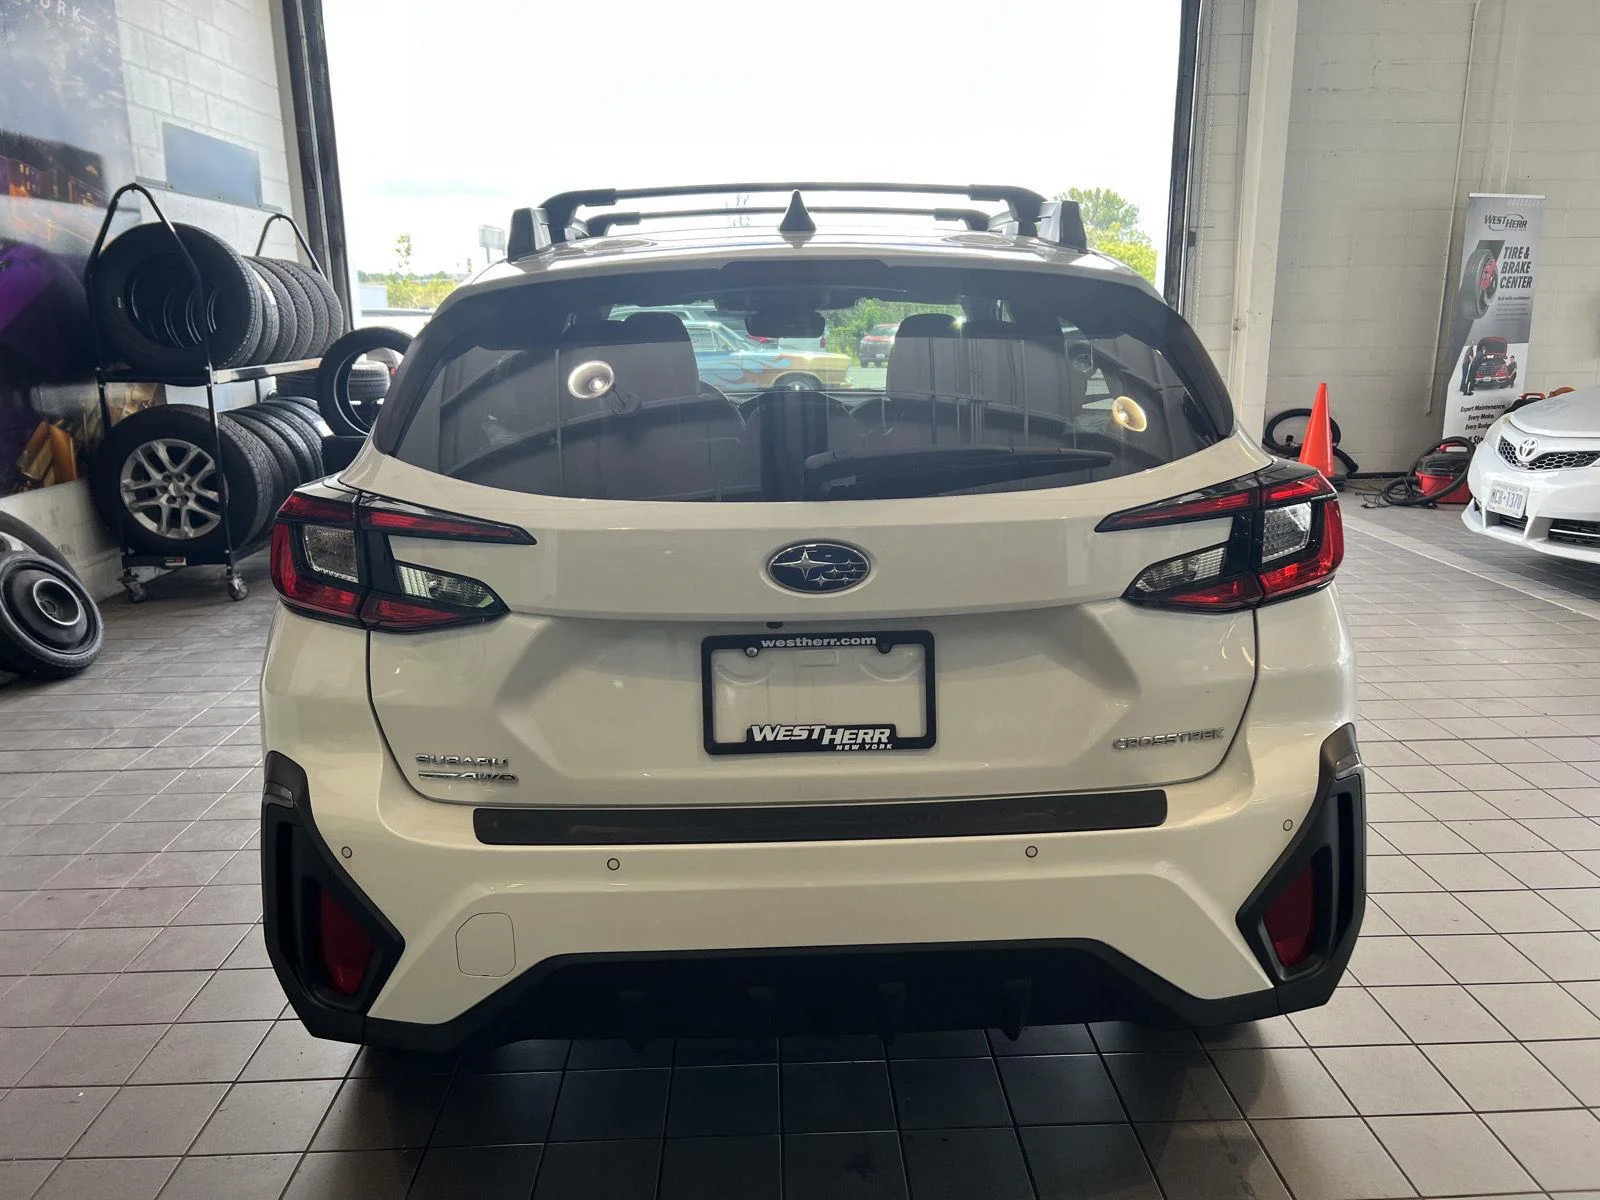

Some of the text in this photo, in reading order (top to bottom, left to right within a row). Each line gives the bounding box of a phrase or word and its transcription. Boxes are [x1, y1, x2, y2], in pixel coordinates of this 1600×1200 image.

[1503, 246, 1531, 260] TIRE &
[1500, 260, 1532, 274] BRAKE
[1499, 275, 1533, 289] CENTER
[1460, 405, 1475, 413] Expert
[1467, 414, 1480, 422] Every
[1464, 421, 1492, 431] Every Budg
[760, 636, 877, 648] westherr.com
[1112, 727, 1224, 751] CROSSTREK
[415, 753, 508, 767] SUBARU
[459, 771, 519, 783] AWD
